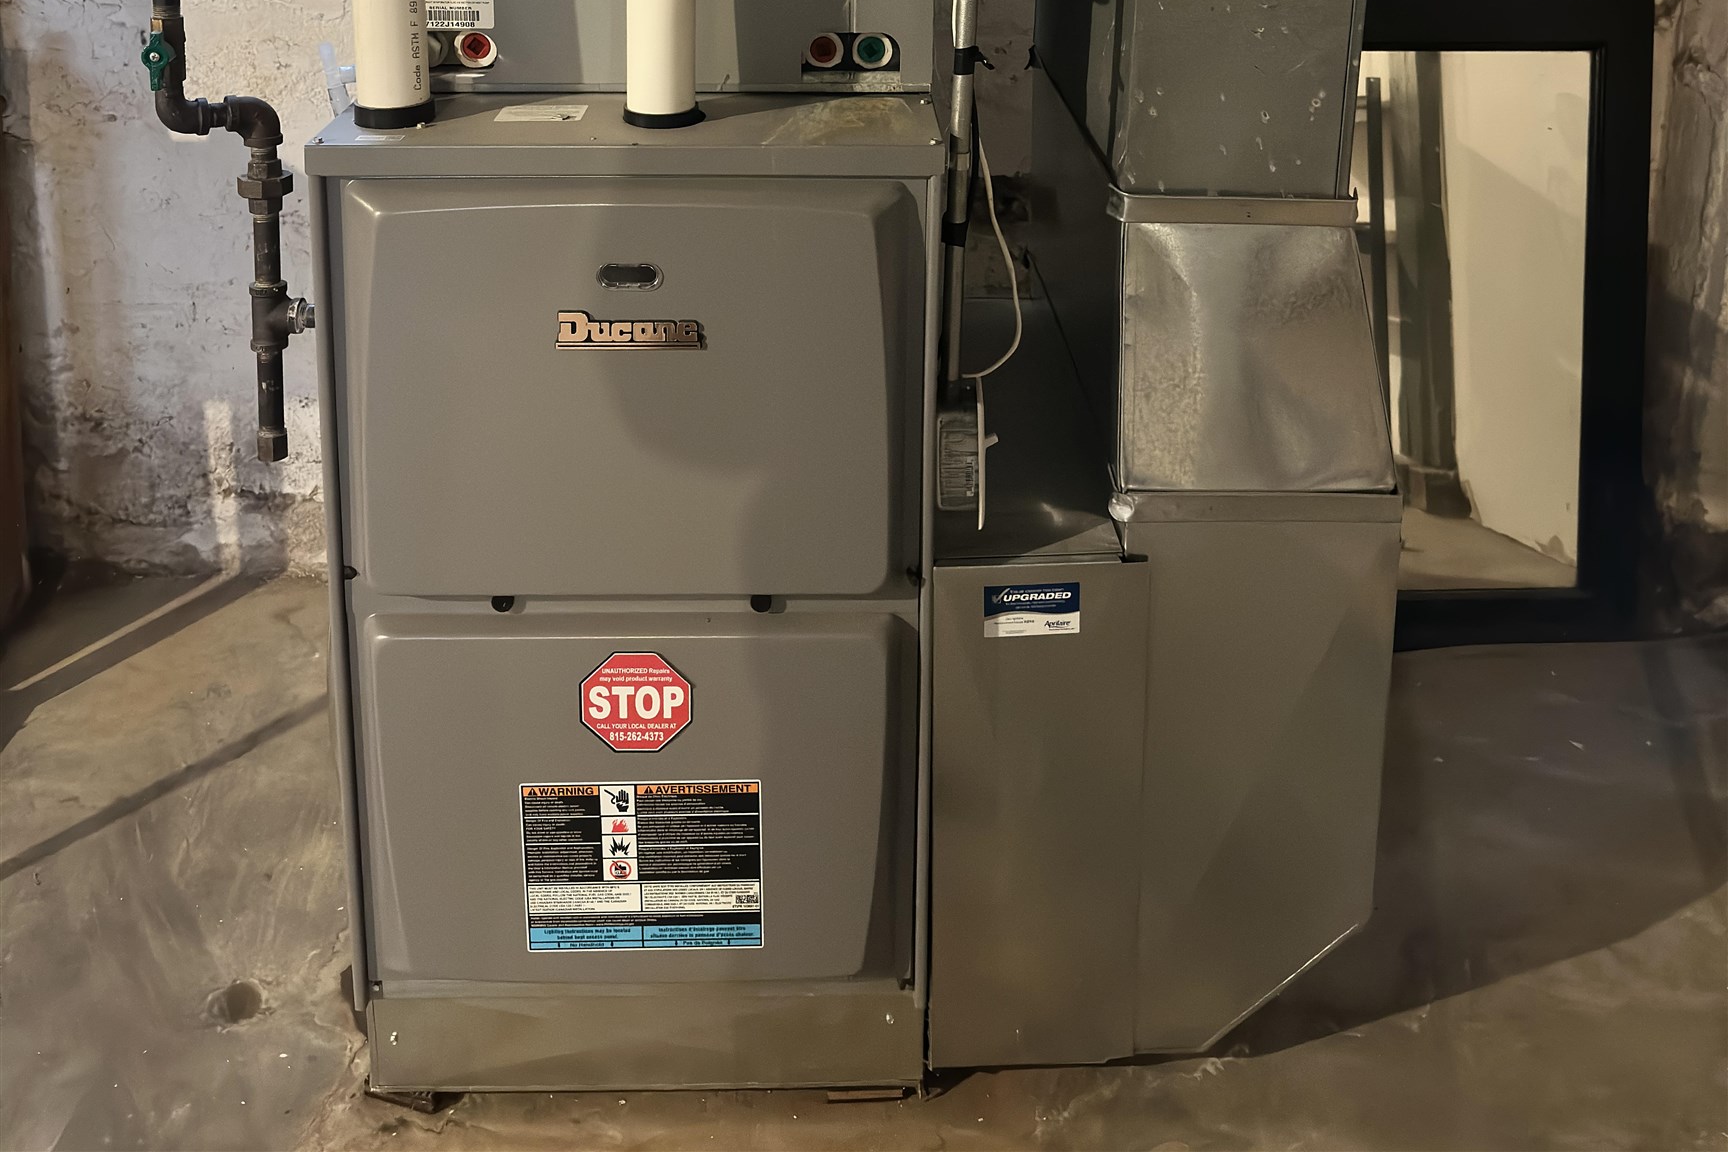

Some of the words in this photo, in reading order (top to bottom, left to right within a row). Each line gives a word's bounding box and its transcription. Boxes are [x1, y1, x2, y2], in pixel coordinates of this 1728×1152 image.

[410, 32, 420, 58] ASTM
[414, 65, 422, 90] Code
[558, 310, 698, 343] Ducane
[1003, 591, 1072, 602] UPGRADED
[588, 686, 685, 720] STOP
[610, 732, 664, 741] 815-262-4373
[539, 787, 594, 796] WARNING
[656, 784, 751, 794] AVERTISSEMENT
